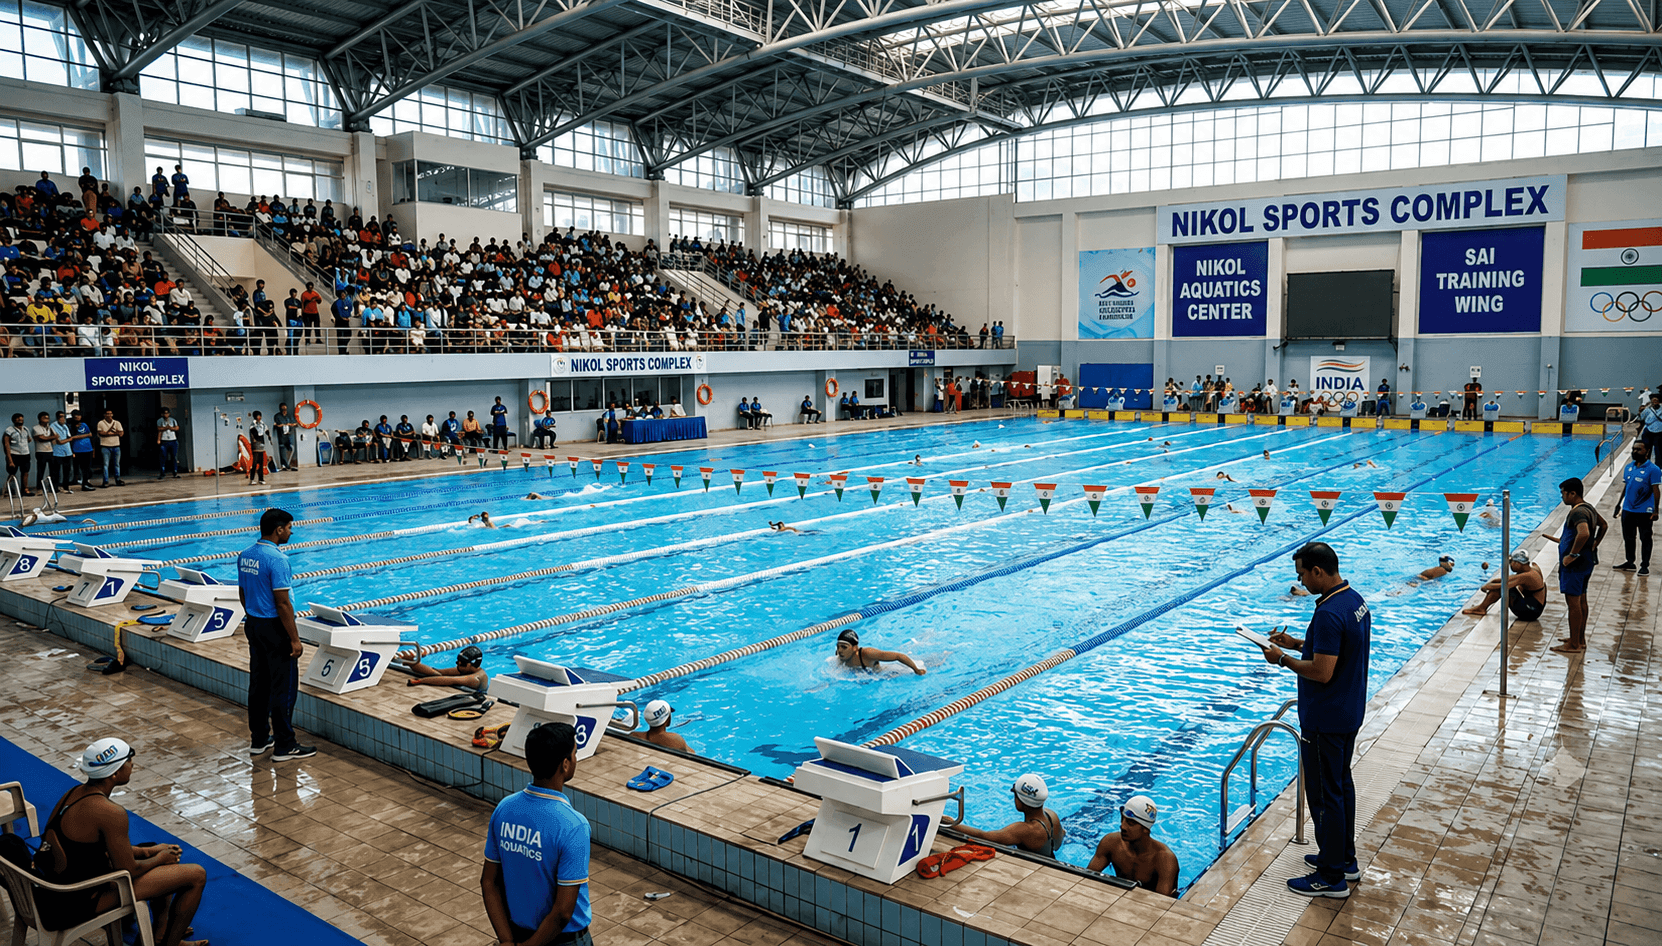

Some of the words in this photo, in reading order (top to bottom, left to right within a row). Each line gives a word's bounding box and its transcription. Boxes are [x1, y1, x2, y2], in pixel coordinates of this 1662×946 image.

[1172, 207, 1254, 237] NIKOL
[1263, 197, 1380, 232] SPORTS
[1390, 185, 1550, 224] COMPLEX
[1465, 247, 1495, 266] SAI
[1196, 258, 1246, 276] NIKOL
[1436, 270, 1525, 290] TRAINING
[1179, 280, 1261, 299] AQUATICS
[1187, 303, 1253, 320] CENTER
[1455, 295, 1504, 313] WING
[119, 362, 157, 372] NIKOL
[571, 358, 603, 372] NIKOL
[606, 357, 645, 371] SPORTS
[648, 357, 692, 370] COMPLEX
[91, 376, 134, 386] SPORTS
[136, 374, 185, 385] COMPLEX
[1316, 377, 1364, 390] INDIA
[20, 558, 30, 571] 8
[214, 612, 224, 628] 5
[359, 658, 370, 677] 5
[500, 821, 542, 848] INDIA
[848, 823, 862, 852] 1
[911, 824, 919, 851] 1
